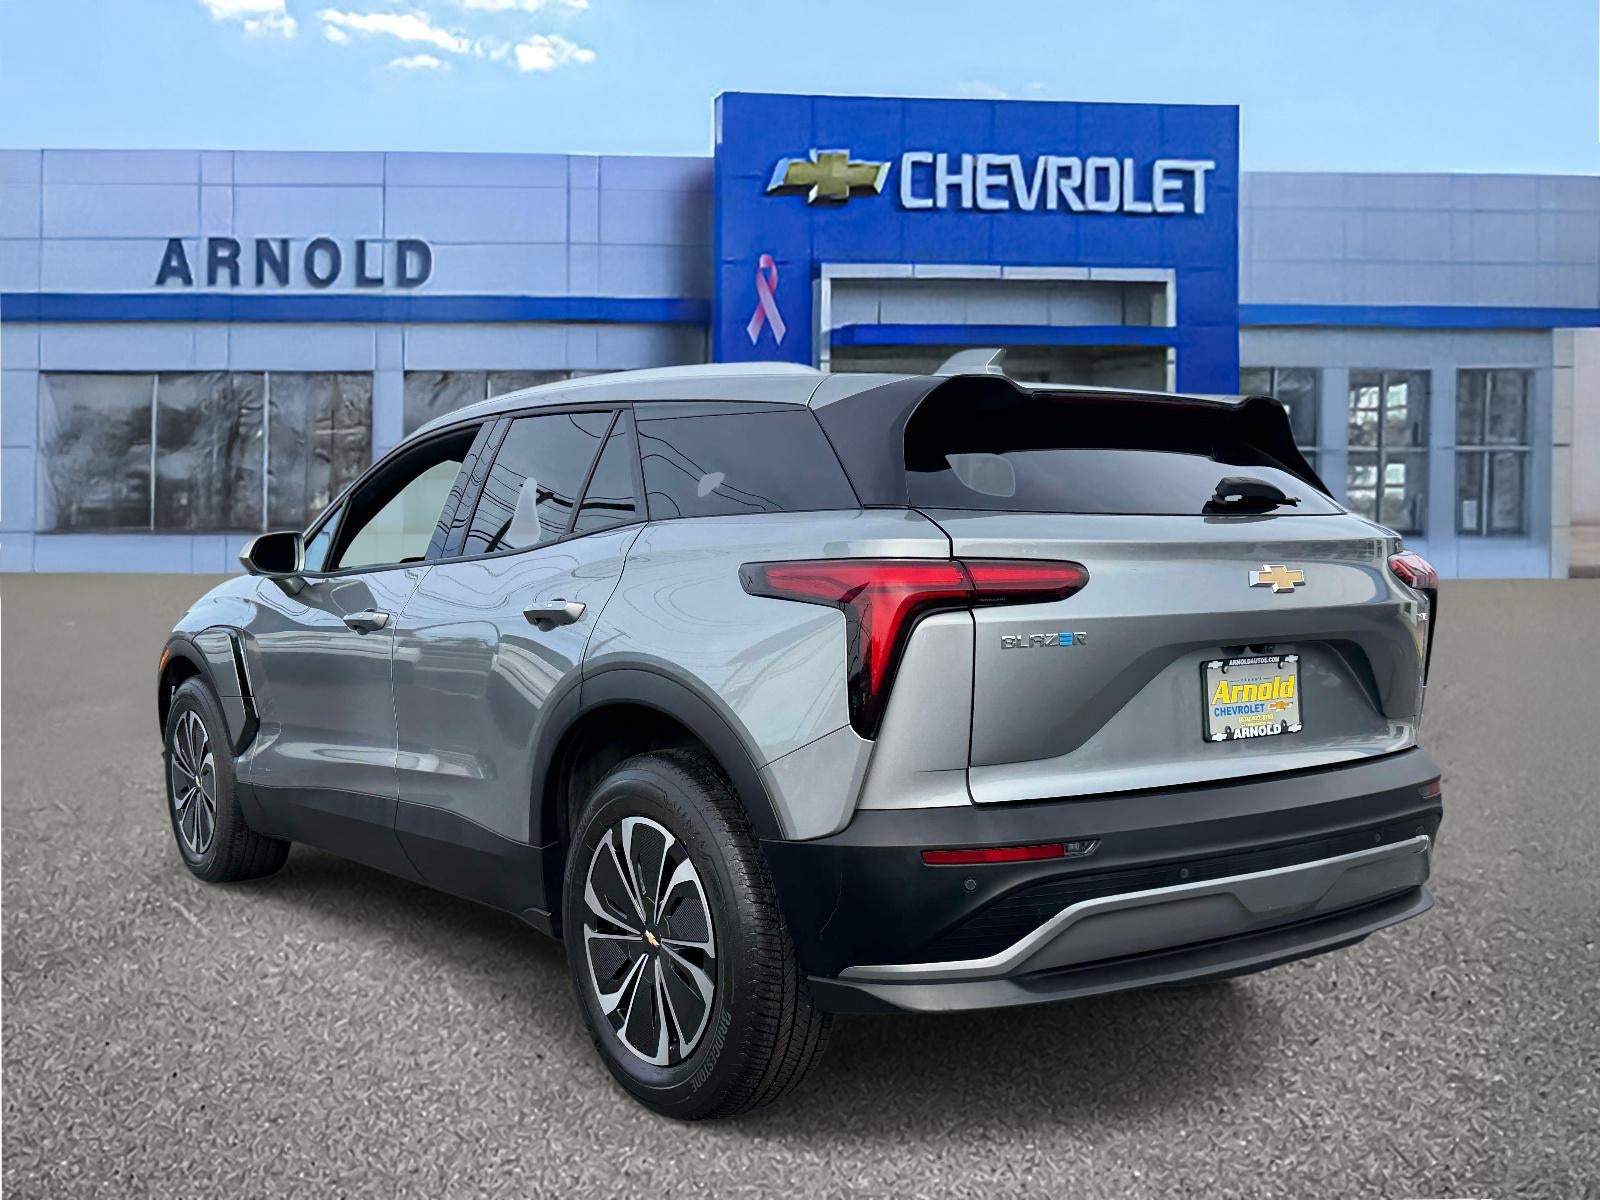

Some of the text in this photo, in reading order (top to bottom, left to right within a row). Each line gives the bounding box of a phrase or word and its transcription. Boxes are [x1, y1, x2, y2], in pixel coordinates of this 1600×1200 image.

[900, 151, 1216, 215] CHEVROLET
[154, 236, 433, 289] ARNOLD
[1001, 631, 1088, 649] BLAZER
[1211, 675, 1295, 705] Arnold
[1214, 703, 1265, 717] CHEVROLET
[1233, 724, 1282, 739] ARNOLD
